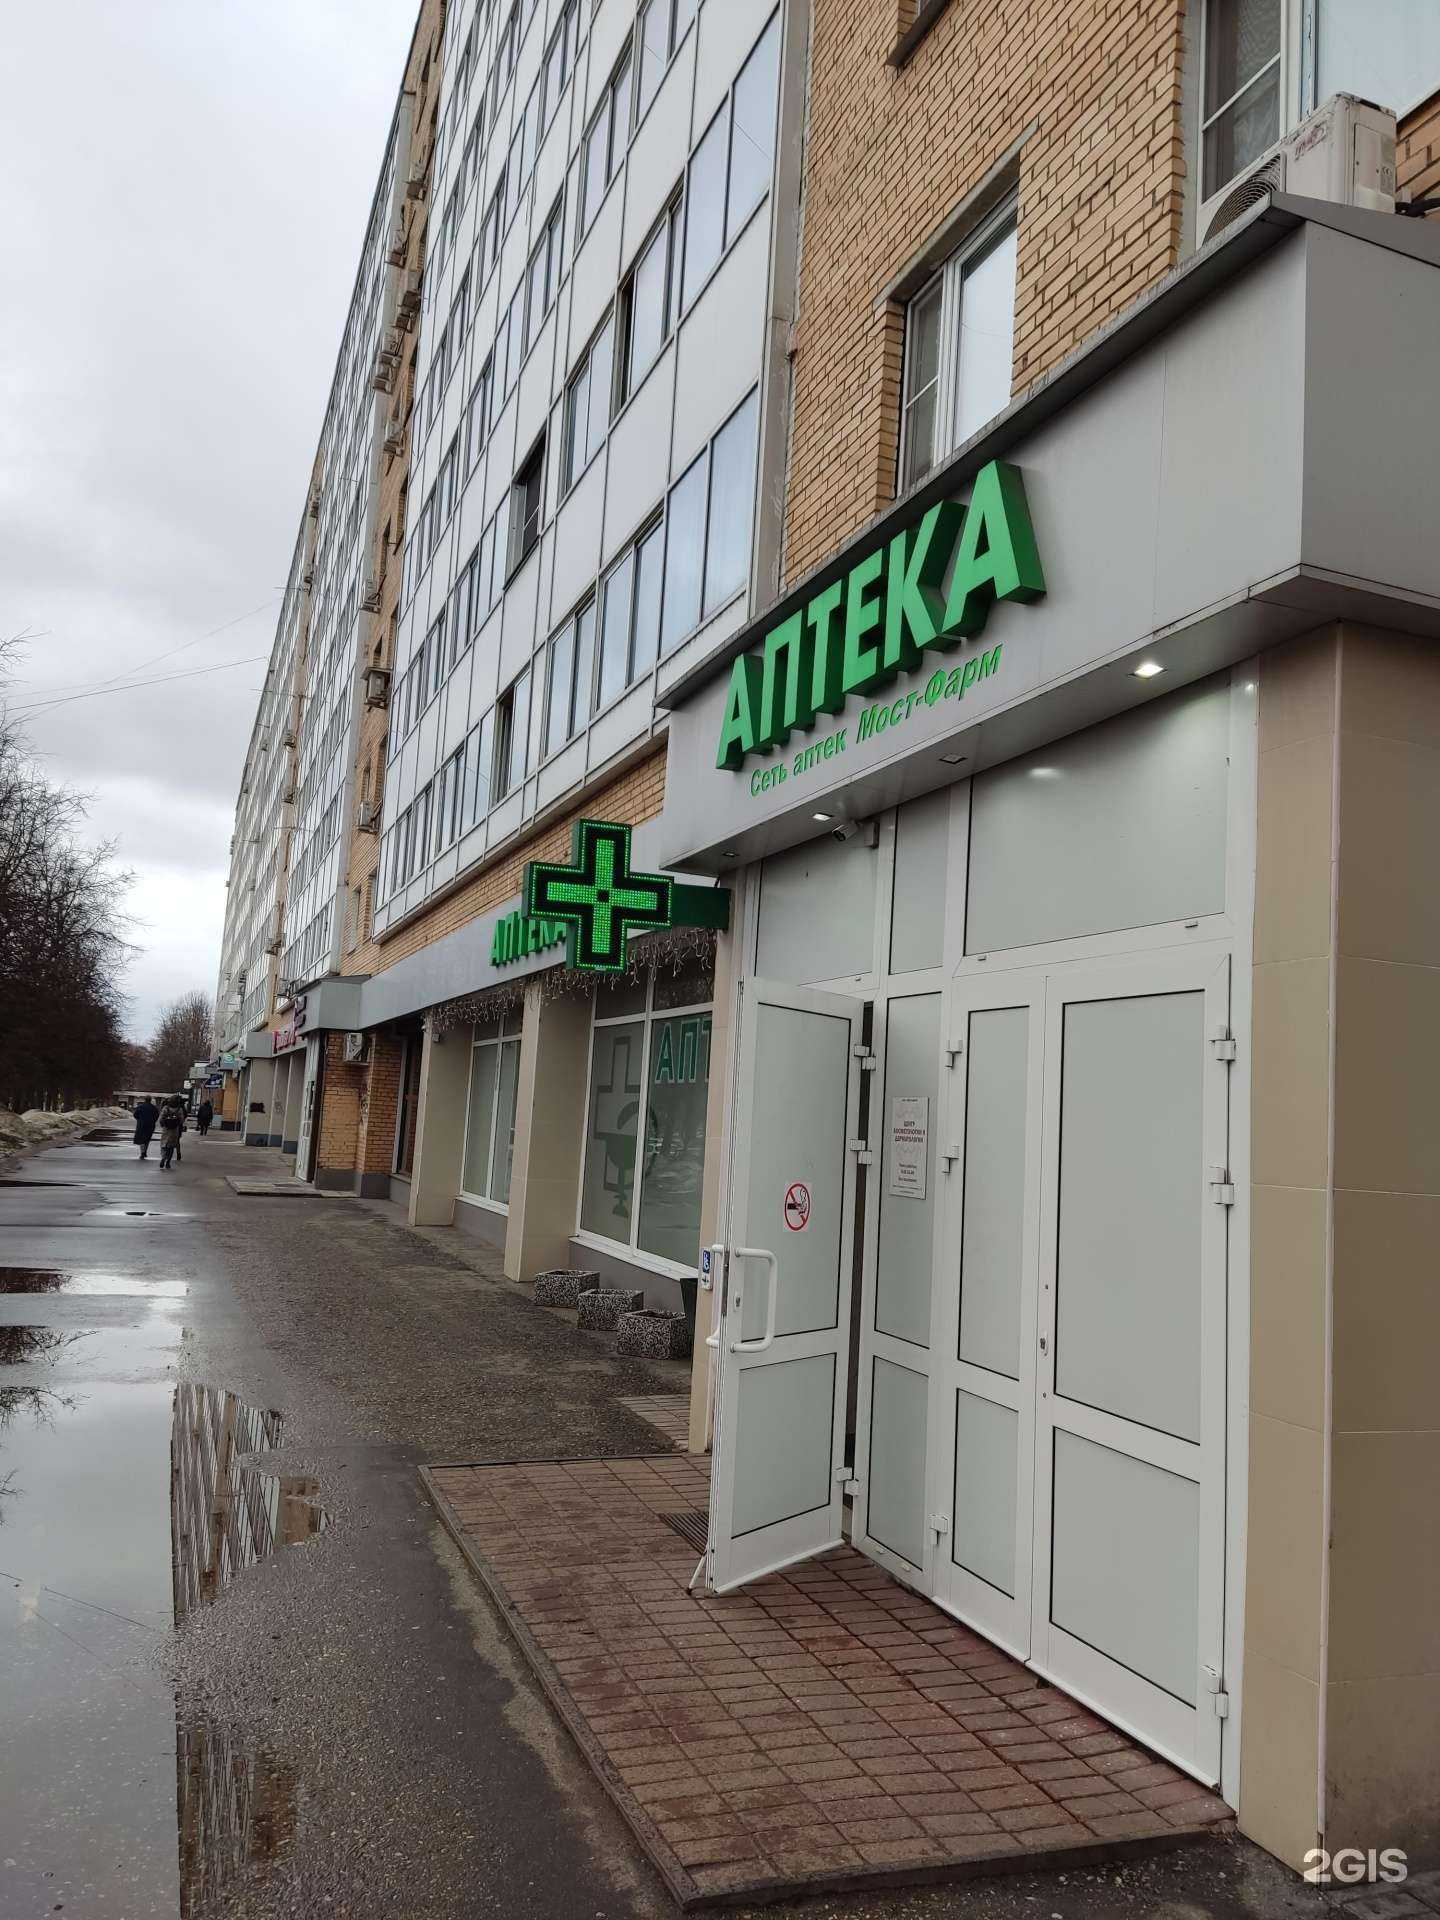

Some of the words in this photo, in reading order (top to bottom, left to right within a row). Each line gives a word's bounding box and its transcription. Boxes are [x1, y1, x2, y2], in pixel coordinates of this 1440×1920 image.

[716, 459, 1045, 770] АПТЕКА
[750, 764, 787, 797] Сеть
[793, 728, 848, 777] аптек
[857, 644, 1003, 744] Мост-Фарм
